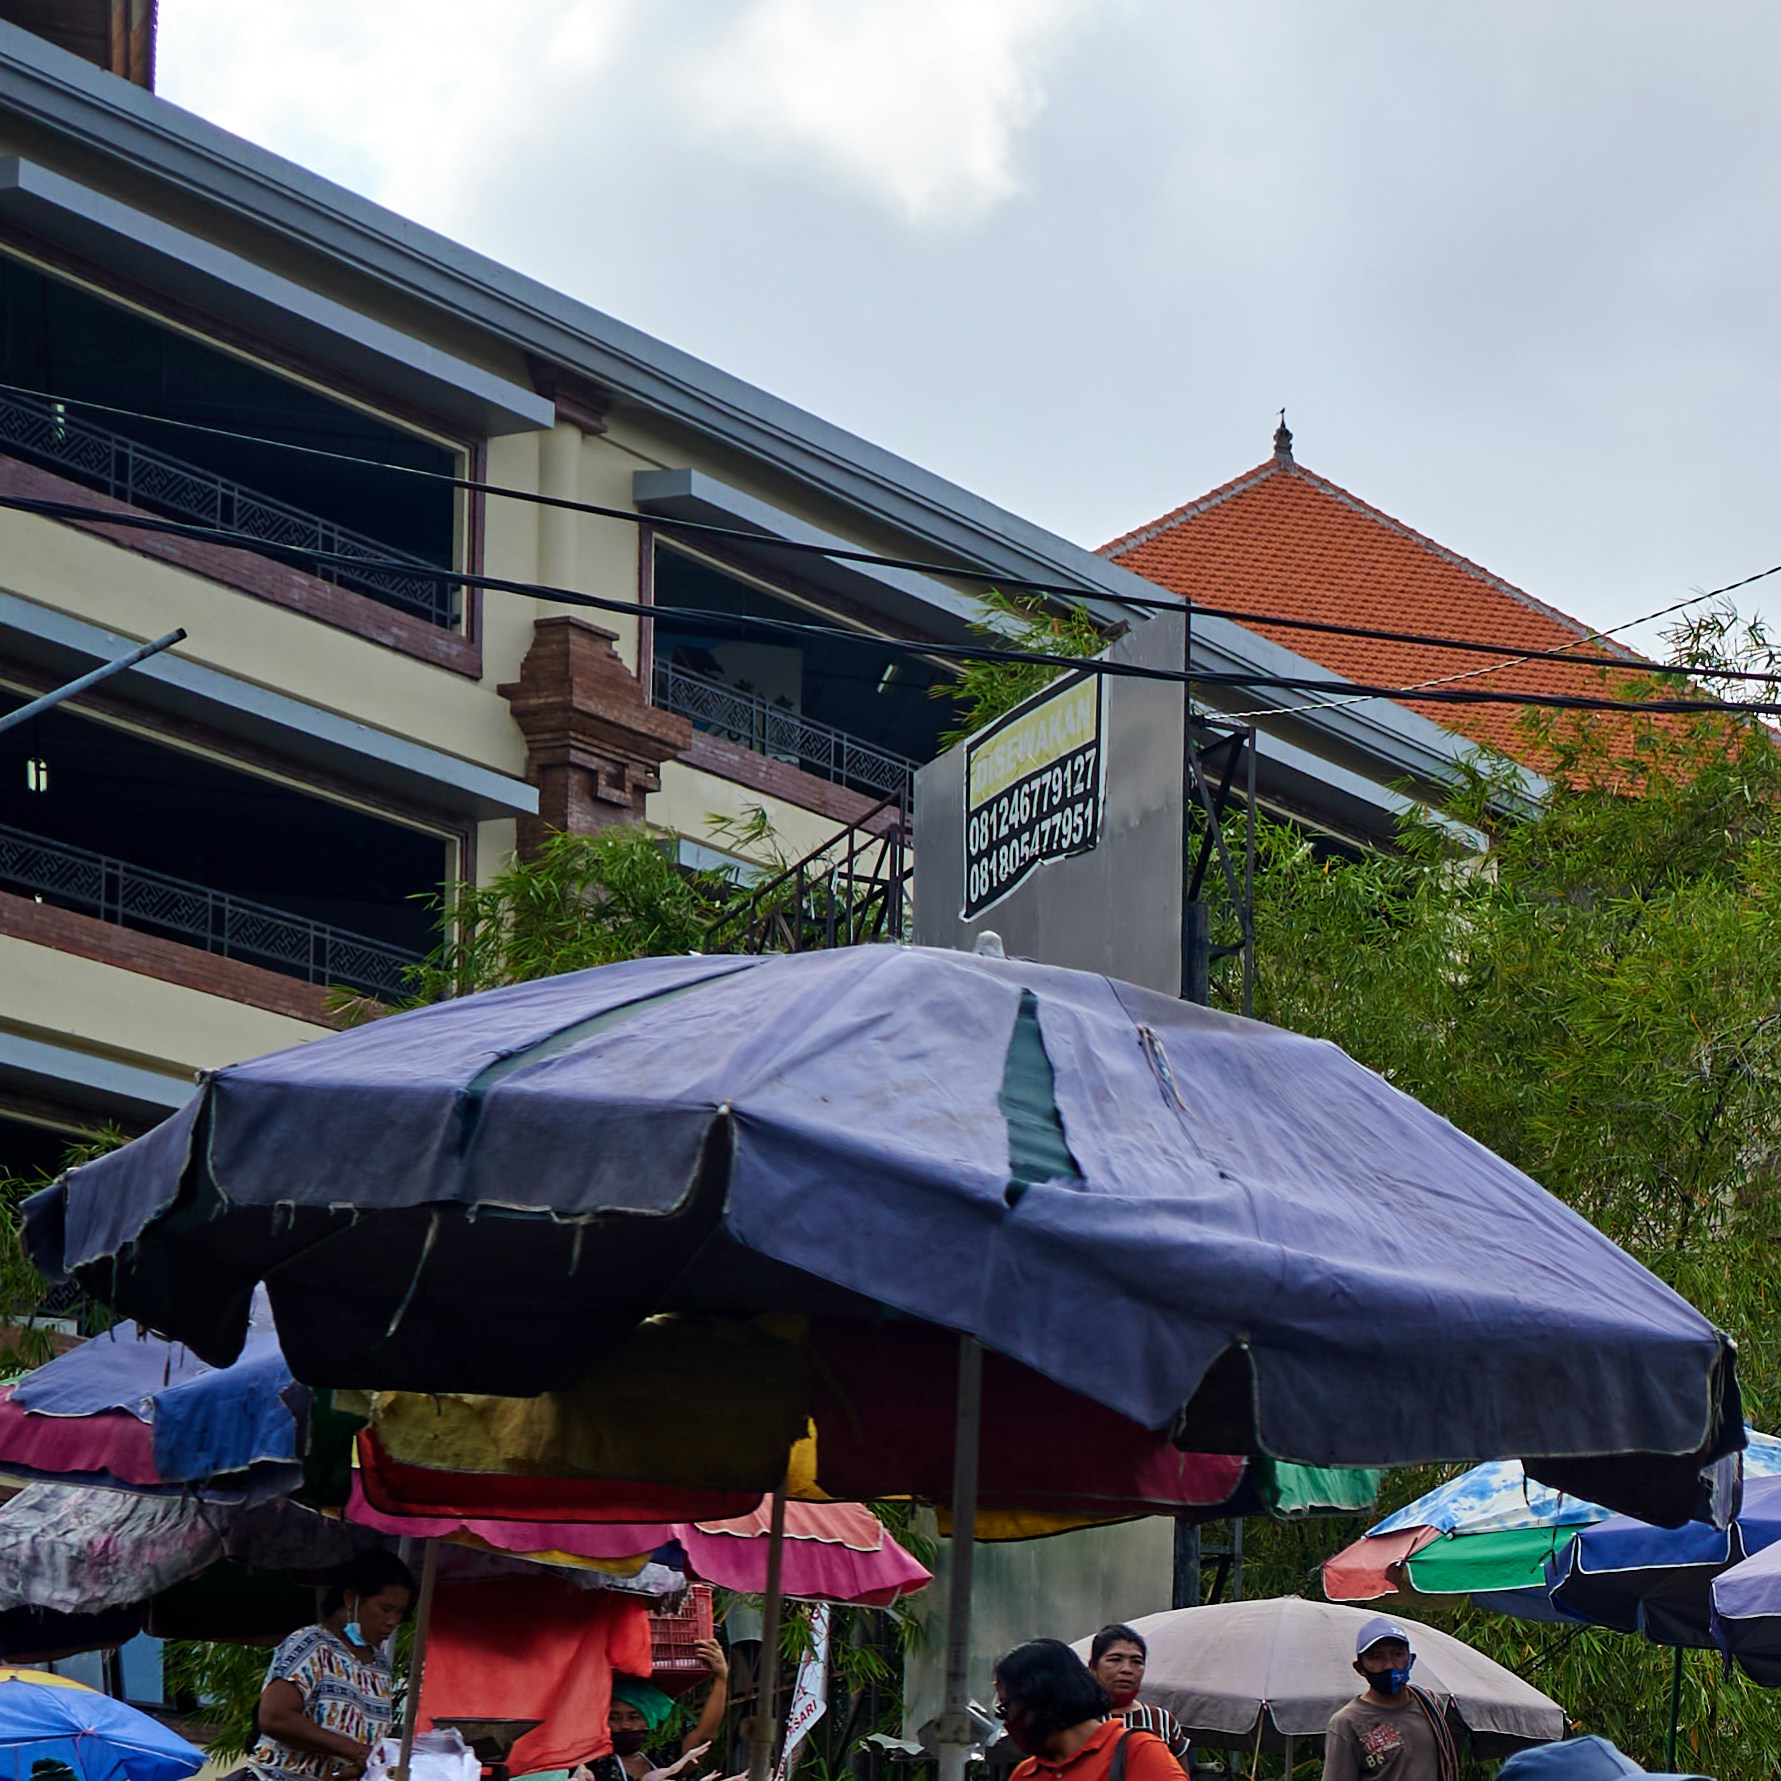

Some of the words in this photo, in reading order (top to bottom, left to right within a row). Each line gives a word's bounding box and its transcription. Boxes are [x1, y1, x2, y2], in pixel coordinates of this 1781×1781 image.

[976, 698, 1091, 786] DISEWAKAN
[969, 747, 1096, 856] 081246779127
[969, 797, 1093, 903] 081805477951
